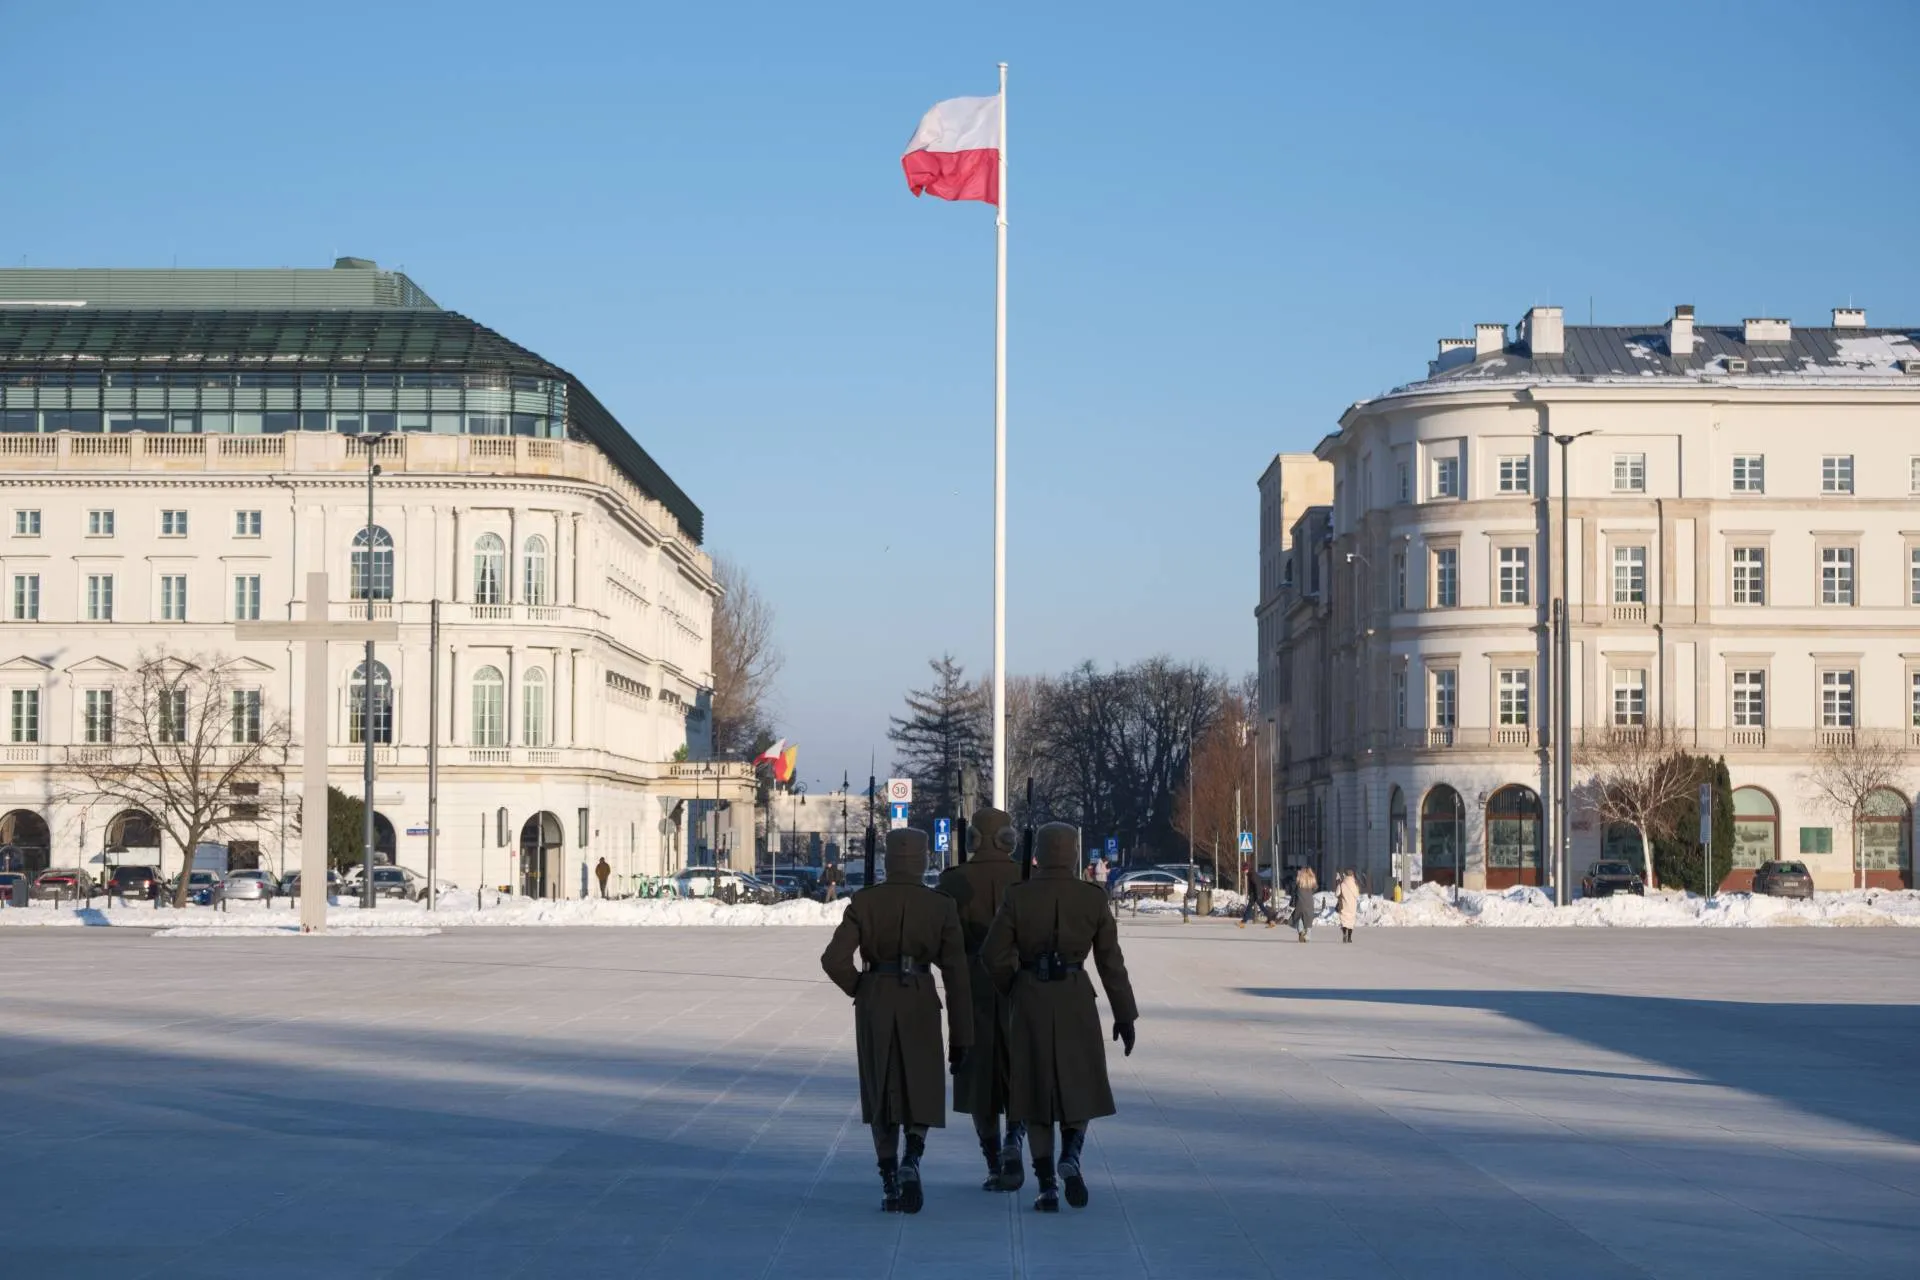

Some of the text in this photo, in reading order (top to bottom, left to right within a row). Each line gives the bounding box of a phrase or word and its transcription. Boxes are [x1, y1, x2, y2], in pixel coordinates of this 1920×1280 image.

[895, 786, 906, 795] 30
[938, 834, 948, 846] P
[1108, 839, 1116, 850] P
